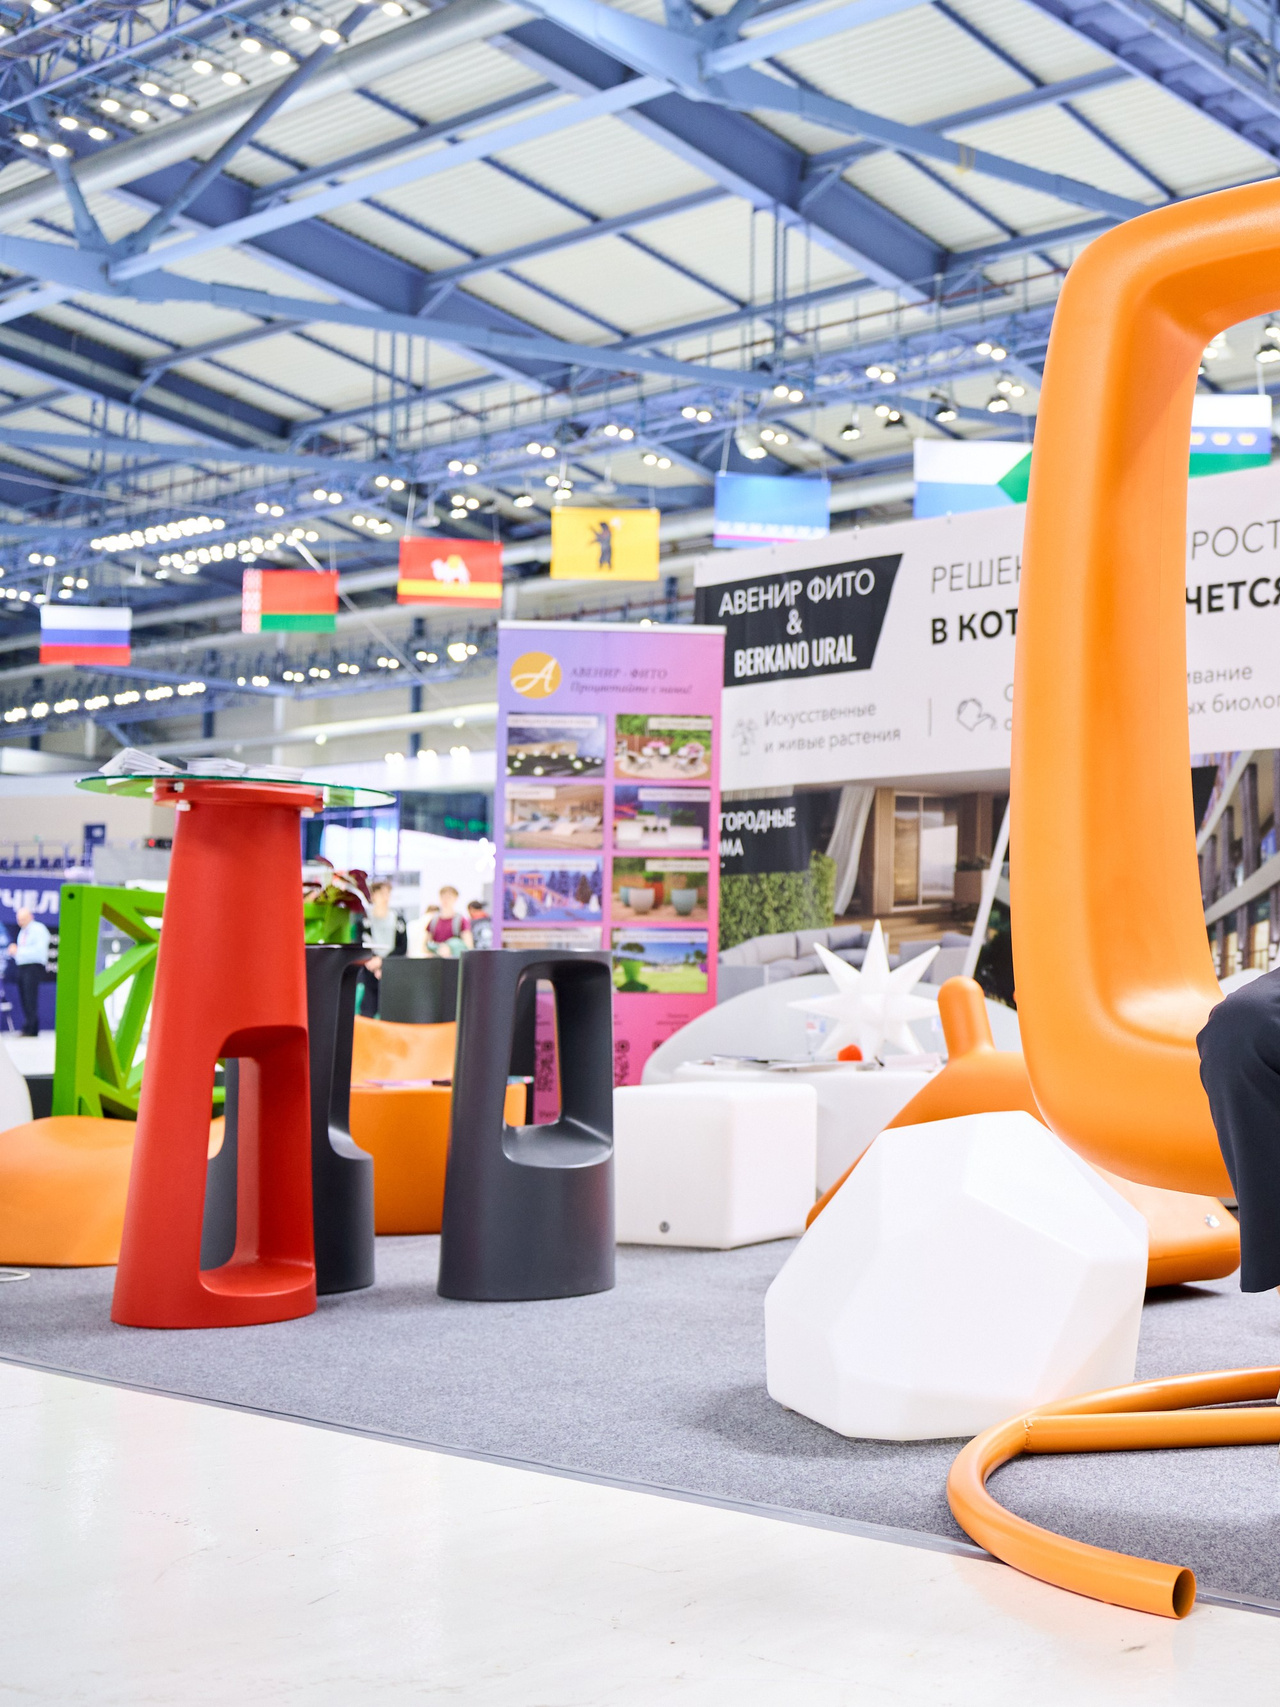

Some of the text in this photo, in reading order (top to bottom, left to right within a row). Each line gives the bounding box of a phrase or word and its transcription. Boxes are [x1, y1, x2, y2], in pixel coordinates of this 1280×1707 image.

[718, 568, 876, 617] АВЕНИР ФИТО
[786, 608, 803, 636] &
[931, 617, 948, 645] В
[958, 607, 1018, 643] КОТ
[733, 633, 857, 679] BERKANO URAL
[764, 702, 876, 729] Искусственные
[829, 728, 901, 752] растения
[718, 806, 796, 834] ГОРОДНЫЕ
